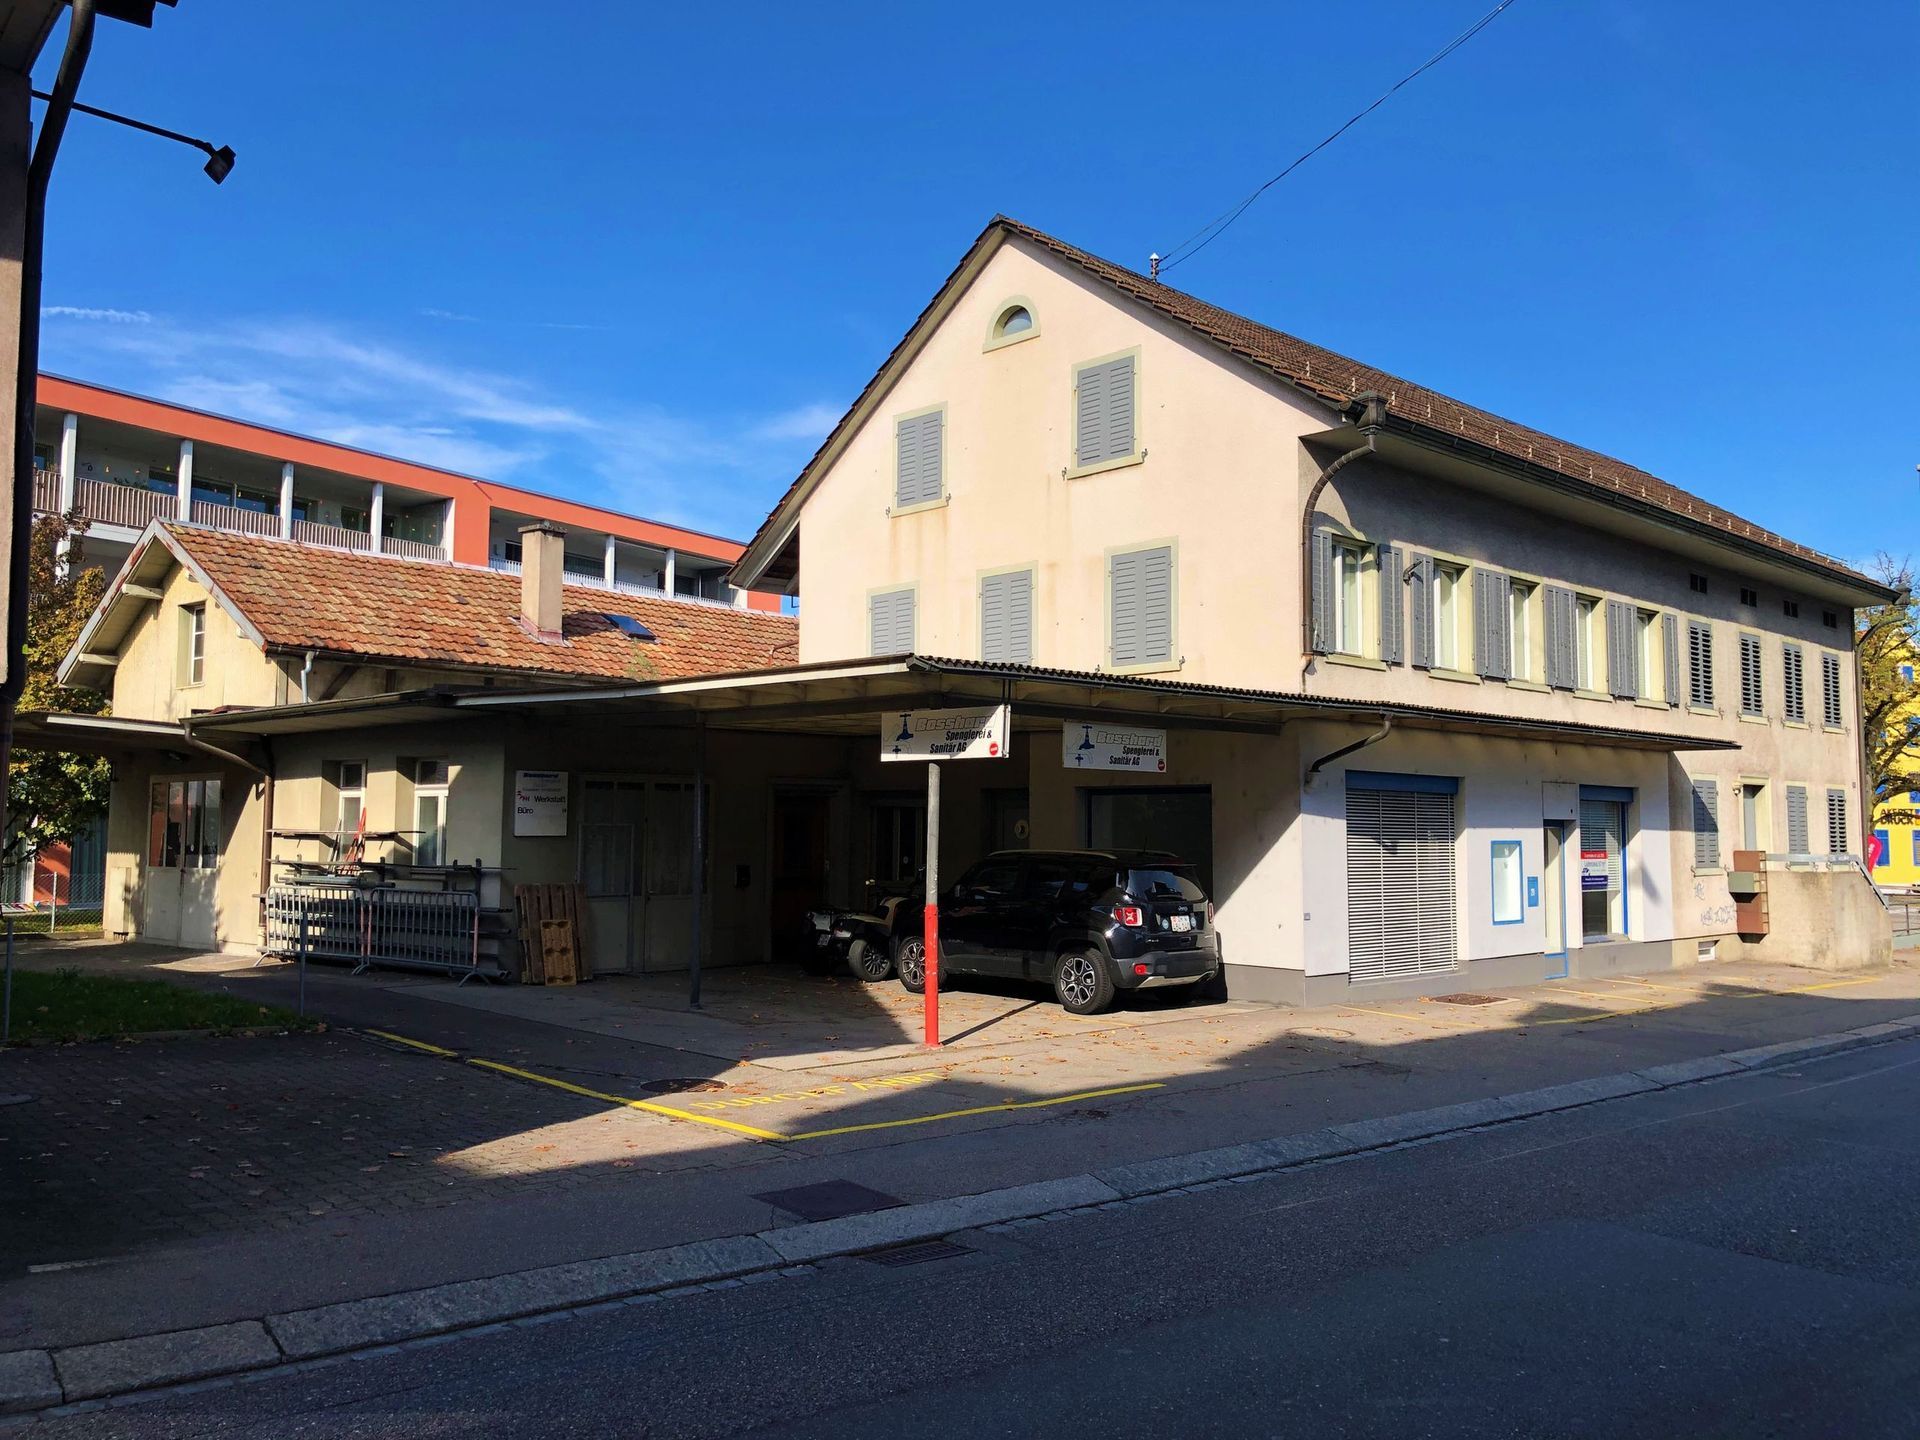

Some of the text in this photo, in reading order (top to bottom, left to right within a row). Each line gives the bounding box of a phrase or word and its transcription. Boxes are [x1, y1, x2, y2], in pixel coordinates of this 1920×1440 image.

[915, 714, 997, 732] Bosshard
[945, 729, 992, 742] Spenglerei &
[1096, 730, 1163, 747] Bosshard
[929, 742, 968, 754] Sanitär AG
[1122, 745, 1155, 757] Spenglerei
[1109, 755, 1141, 766] Sanitär AG
[534, 795, 566, 803] Werkstatt
[517, 806, 534, 814] Büro
